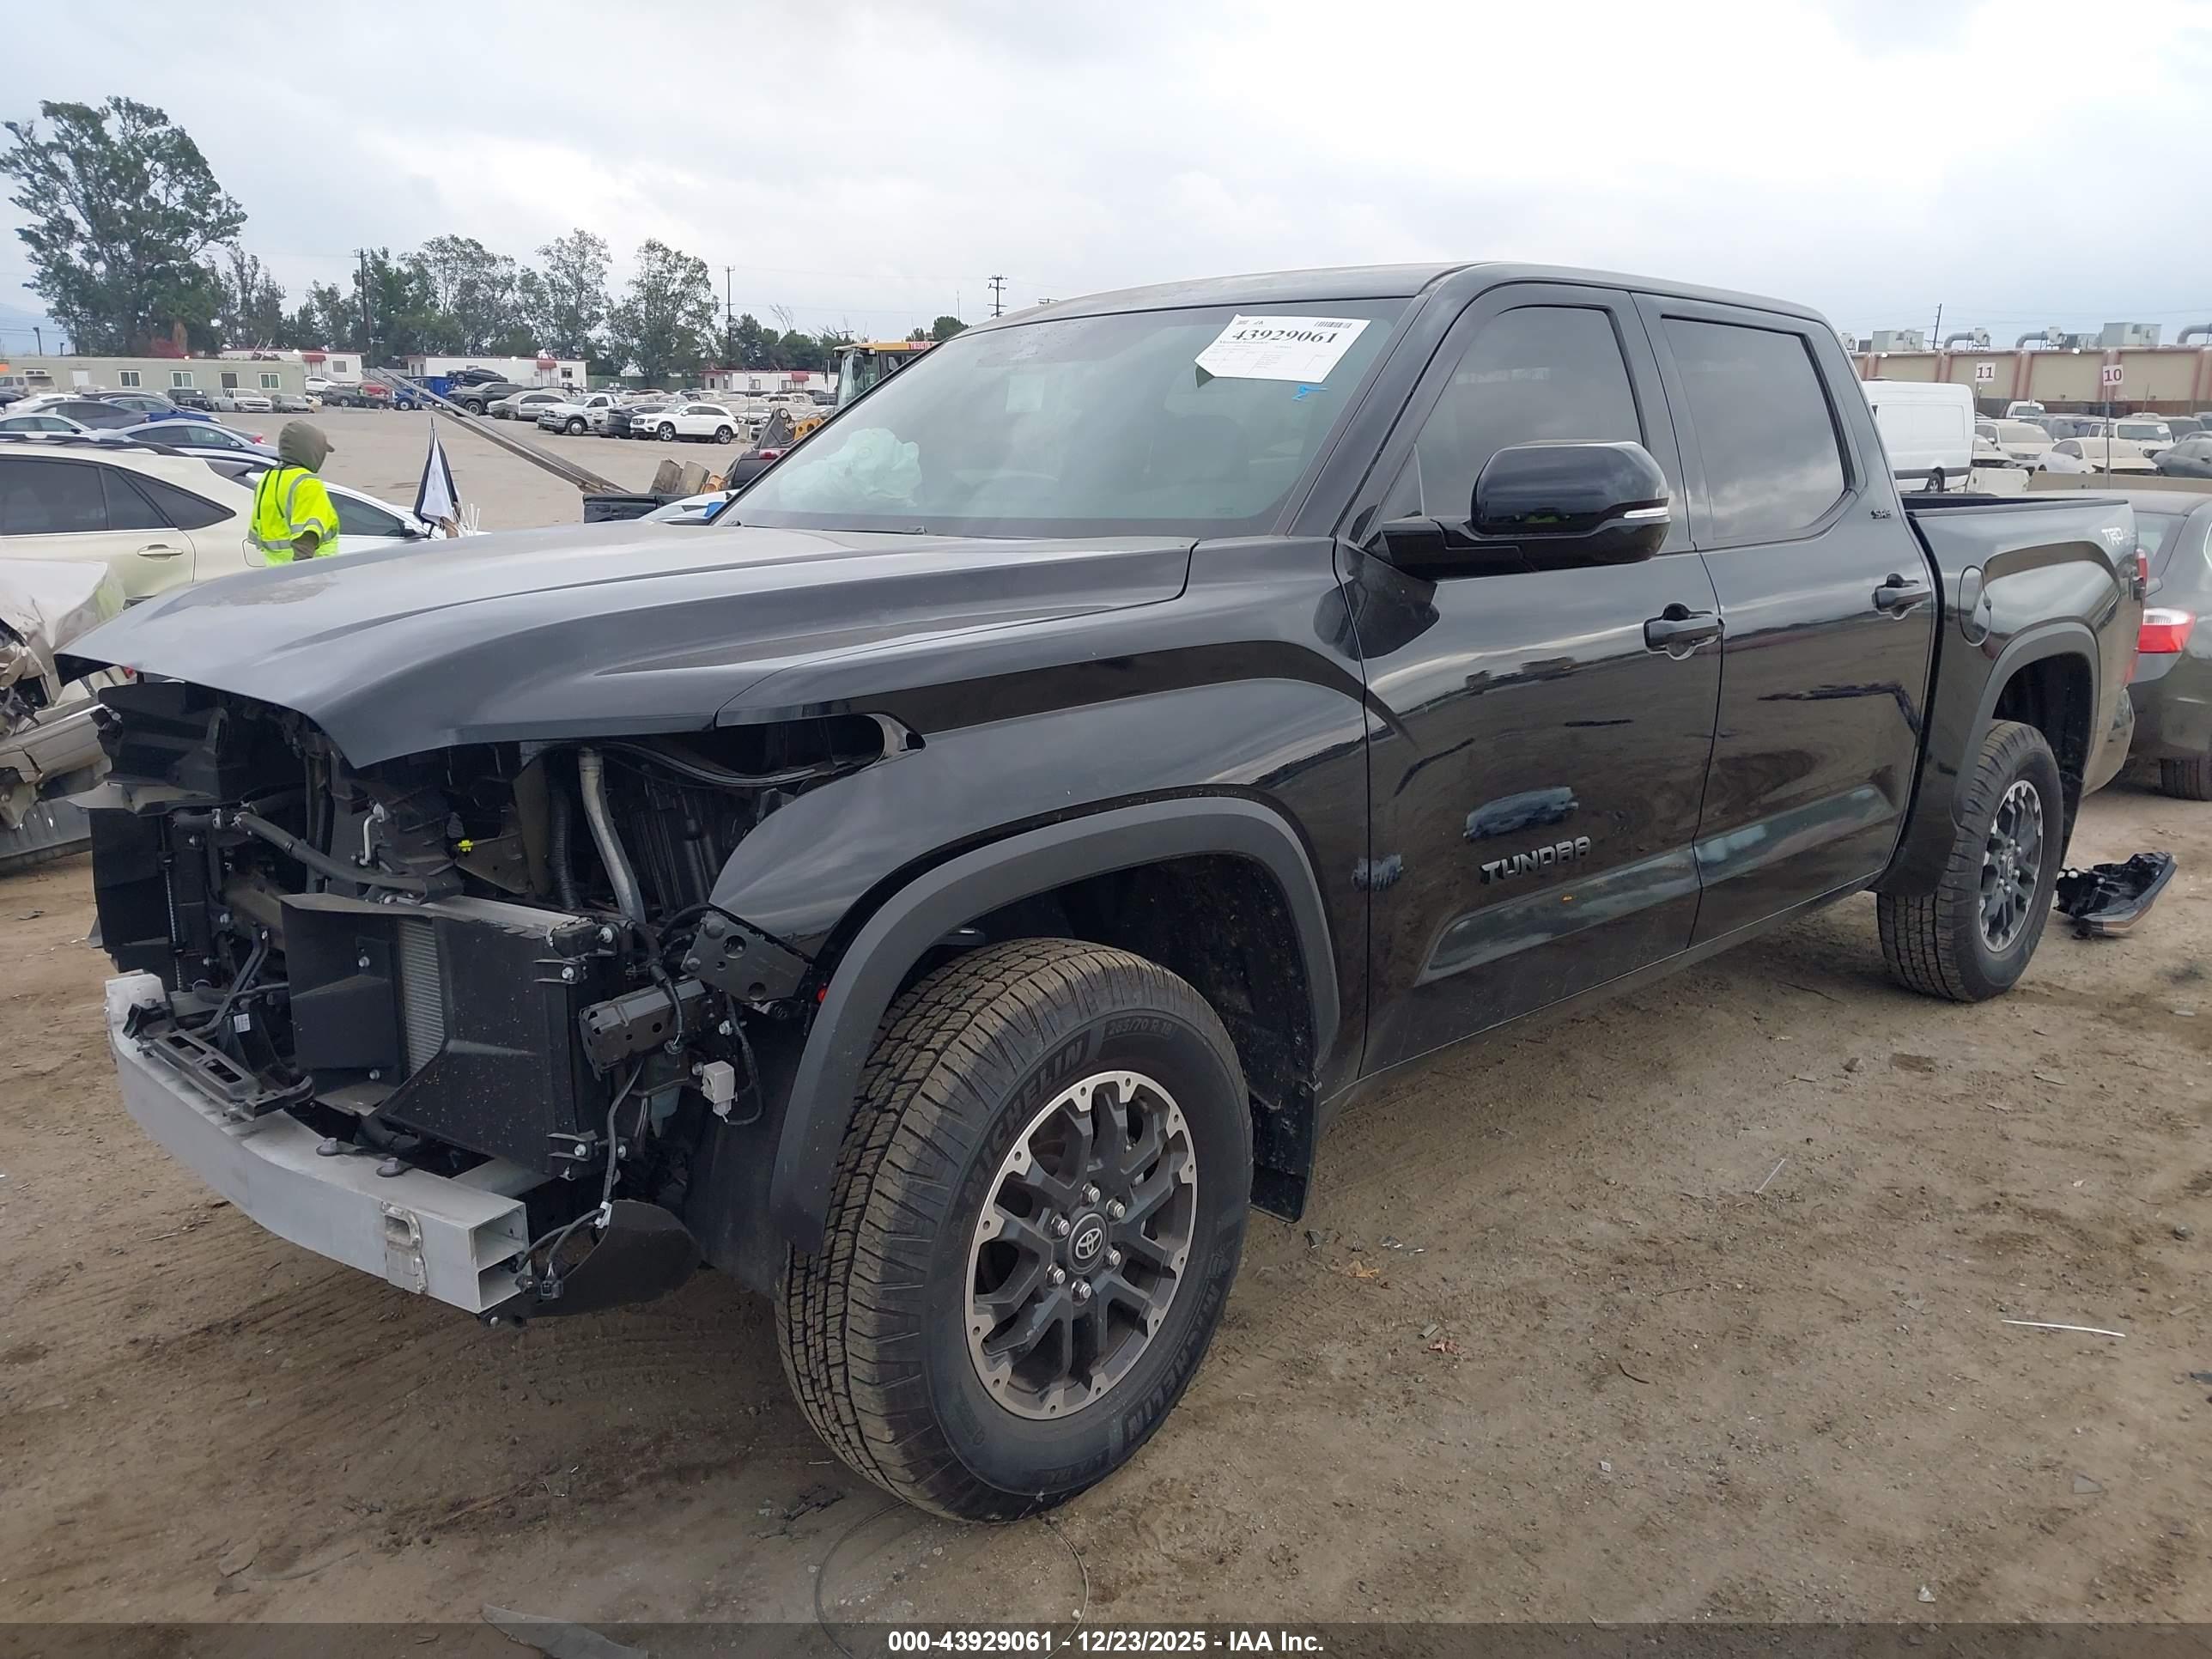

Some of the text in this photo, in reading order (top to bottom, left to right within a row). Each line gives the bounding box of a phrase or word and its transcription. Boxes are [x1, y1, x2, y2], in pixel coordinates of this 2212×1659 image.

[1232, 329, 1340, 344] 43929061
[1977, 366, 1994, 379] 11
[2104, 368, 2123, 382] 10
[2101, 527, 2124, 546] TRD
[1480, 836, 1592, 884] TUNDRA
[963, 1039, 1083, 1202] MICHELIN
